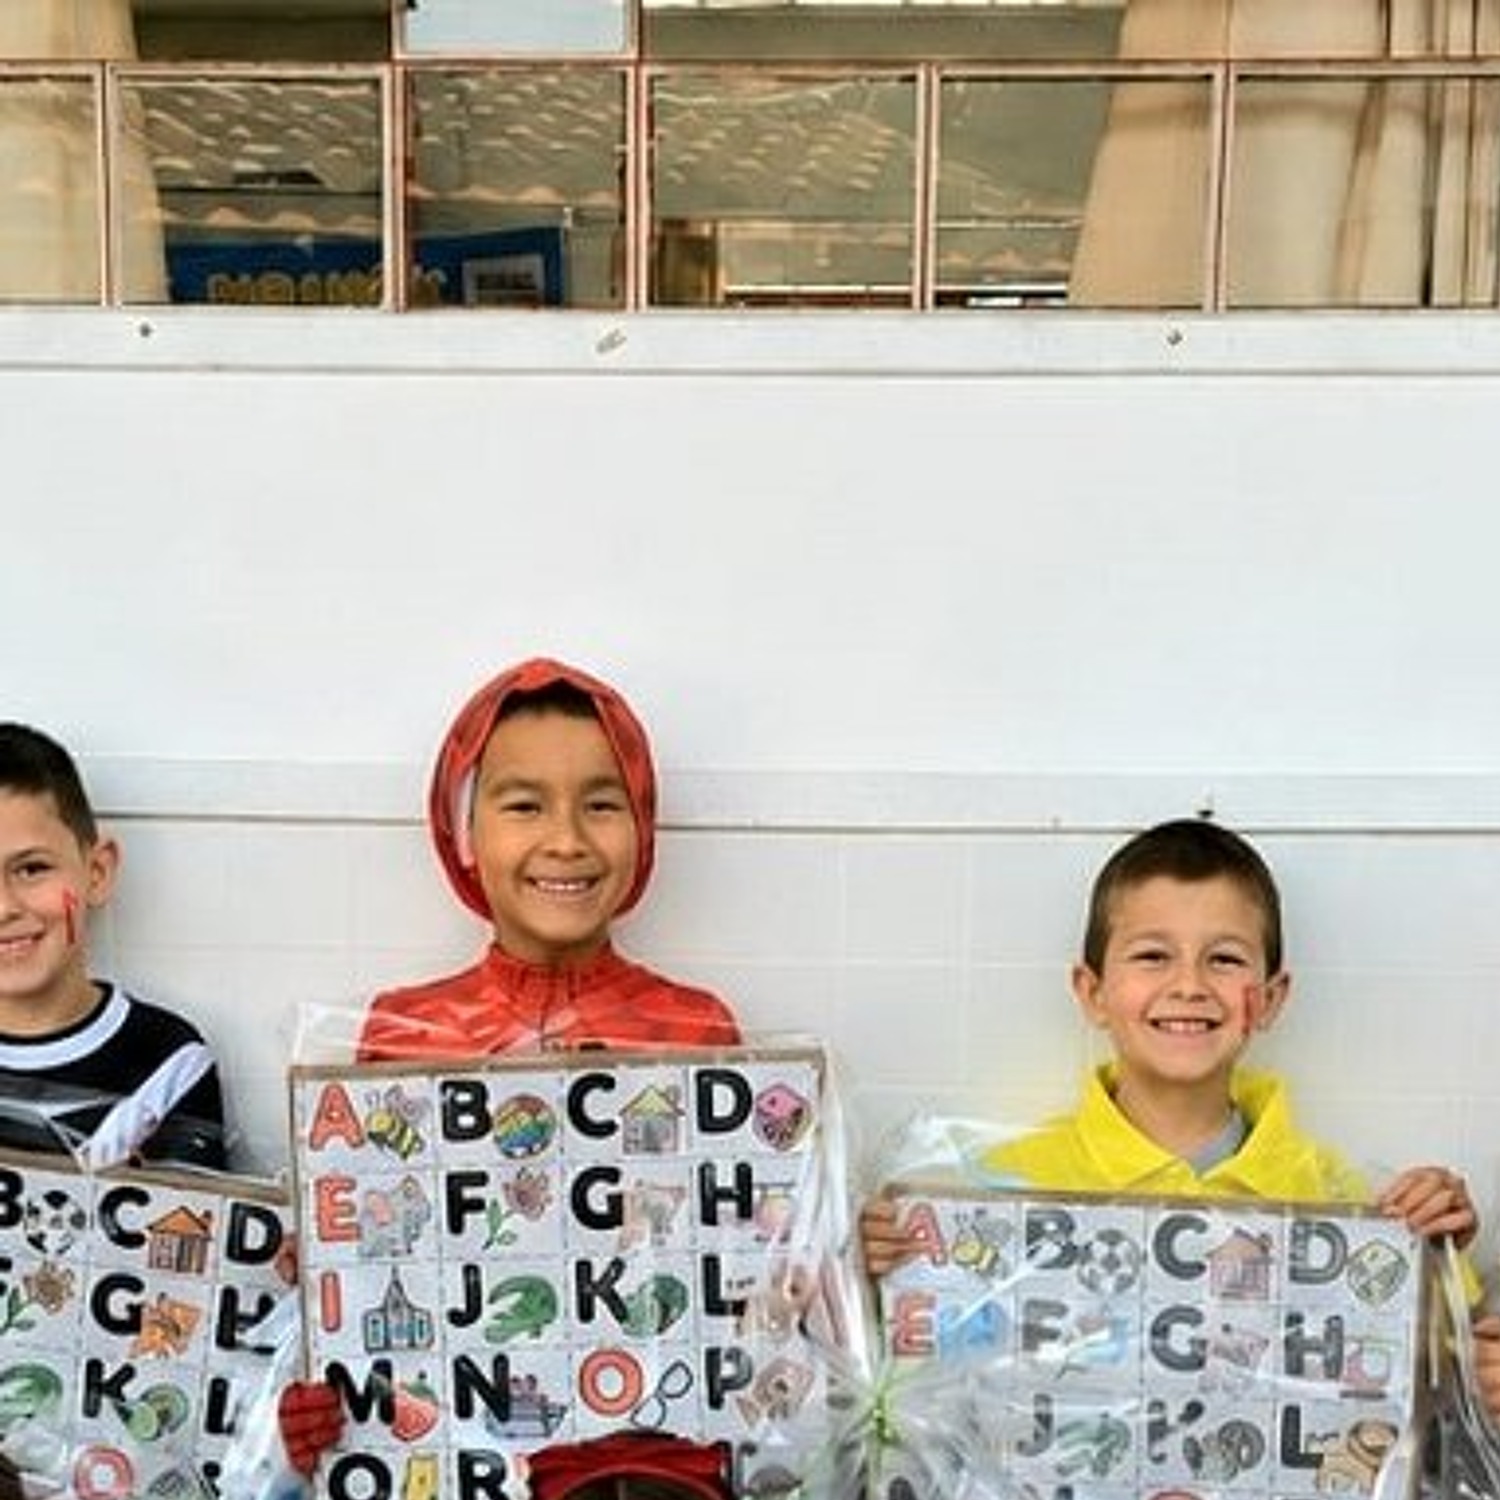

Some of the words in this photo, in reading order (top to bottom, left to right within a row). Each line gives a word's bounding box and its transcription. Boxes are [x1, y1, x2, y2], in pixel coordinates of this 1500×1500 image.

[309, 1083, 364, 1150] A
[439, 1078, 491, 1141] B
[566, 1074, 618, 1140] C
[695, 1070, 754, 1134] D
[98, 1186, 150, 1249] C
[225, 1201, 284, 1264] D
[314, 1175, 360, 1242] E
[446, 1171, 489, 1235] F
[570, 1166, 624, 1230] G
[699, 1162, 754, 1226] H
[900, 1204, 945, 1265] A
[1025, 1210, 1077, 1270] B
[1152, 1214, 1208, 1280] C
[1287, 1220, 1347, 1285] D
[90, 1273, 145, 1336] G
[448, 1264, 482, 1328] J
[575, 1257, 629, 1325] K
[703, 1254, 745, 1317] L
[893, 1294, 936, 1356] E
[1148, 1305, 1207, 1371] G
[1284, 1312, 1344, 1377] H
[83, 1358, 136, 1418] K
[326, 1359, 395, 1424] M
[453, 1354, 510, 1421] N
[578, 1347, 643, 1417] O
[704, 1348, 753, 1410] P
[1280, 1405, 1323, 1469] L
